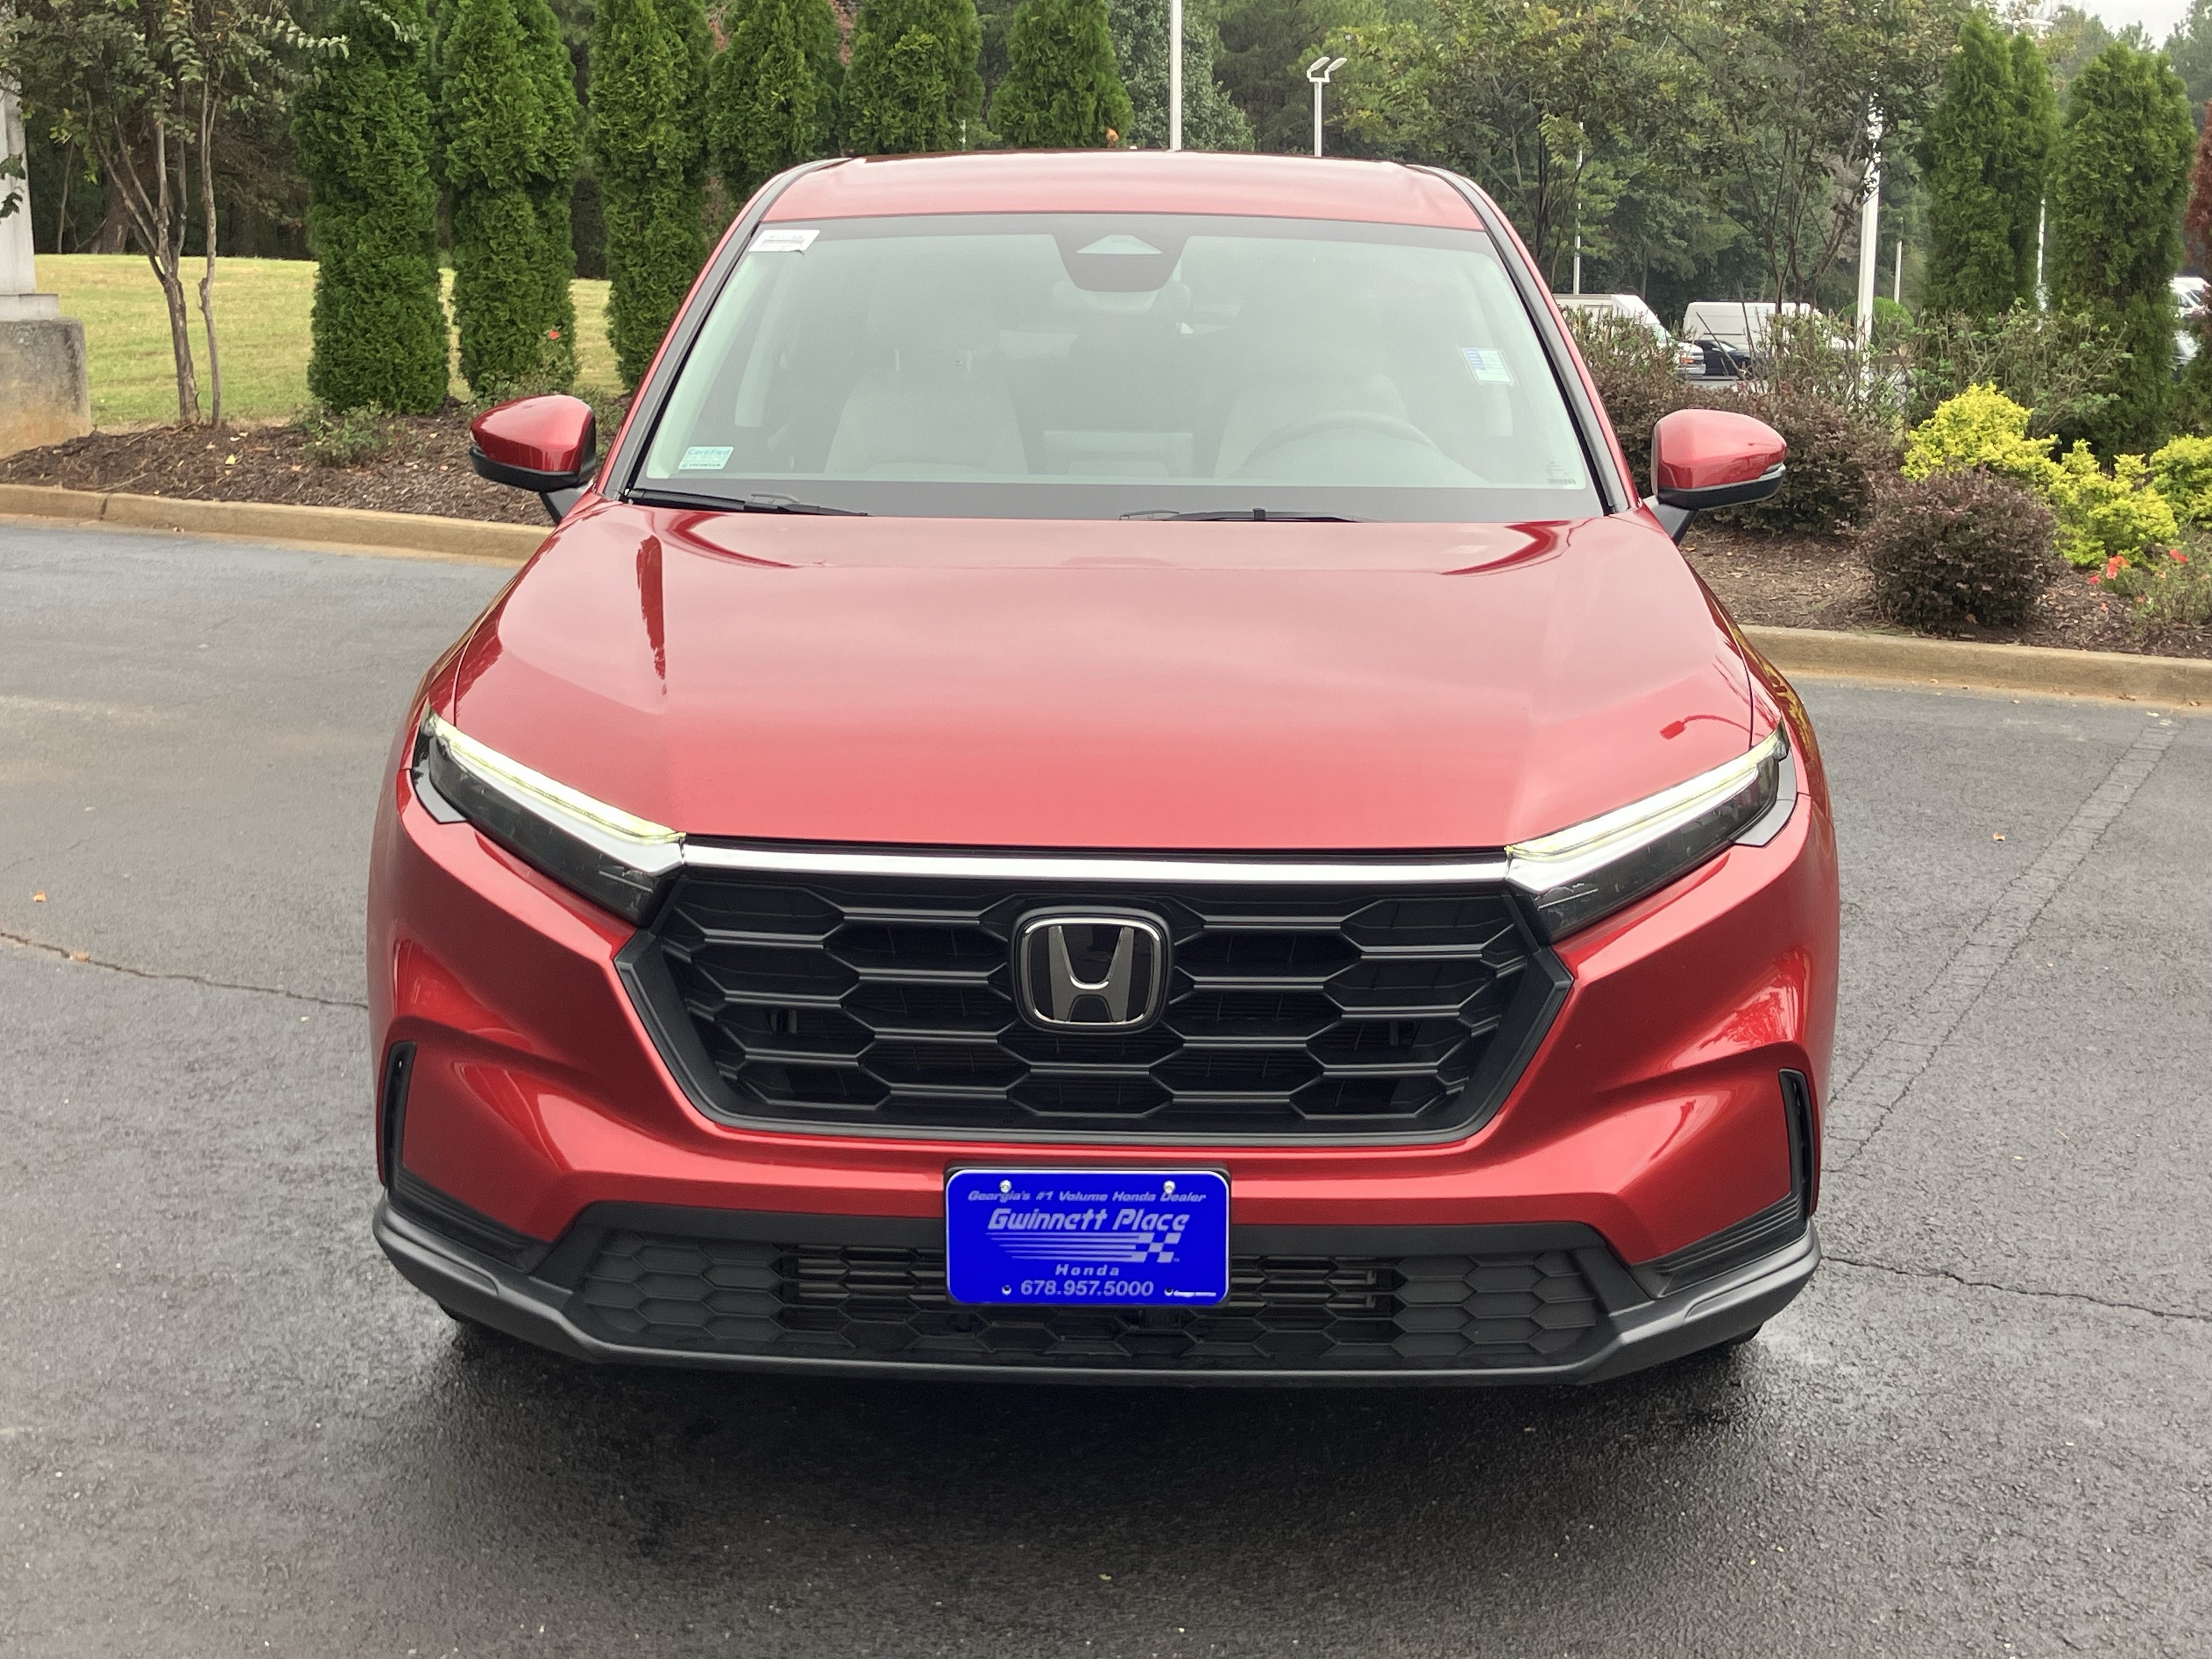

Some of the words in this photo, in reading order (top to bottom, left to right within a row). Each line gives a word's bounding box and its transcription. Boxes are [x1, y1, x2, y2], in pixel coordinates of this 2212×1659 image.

[968, 1190, 1031, 1203] Georgia's
[1036, 1190, 1054, 1201] #1
[1059, 1190, 1108, 1201] Volume
[1112, 1191, 1156, 1202] Honda
[1160, 1192, 1206, 1202] Dealer
[988, 1208, 1108, 1231] Gwinnett
[1112, 1208, 1190, 1232] Place
[1055, 1264, 1120, 1276] Honda
[1020, 1280, 1154, 1296] 678.957.5000
